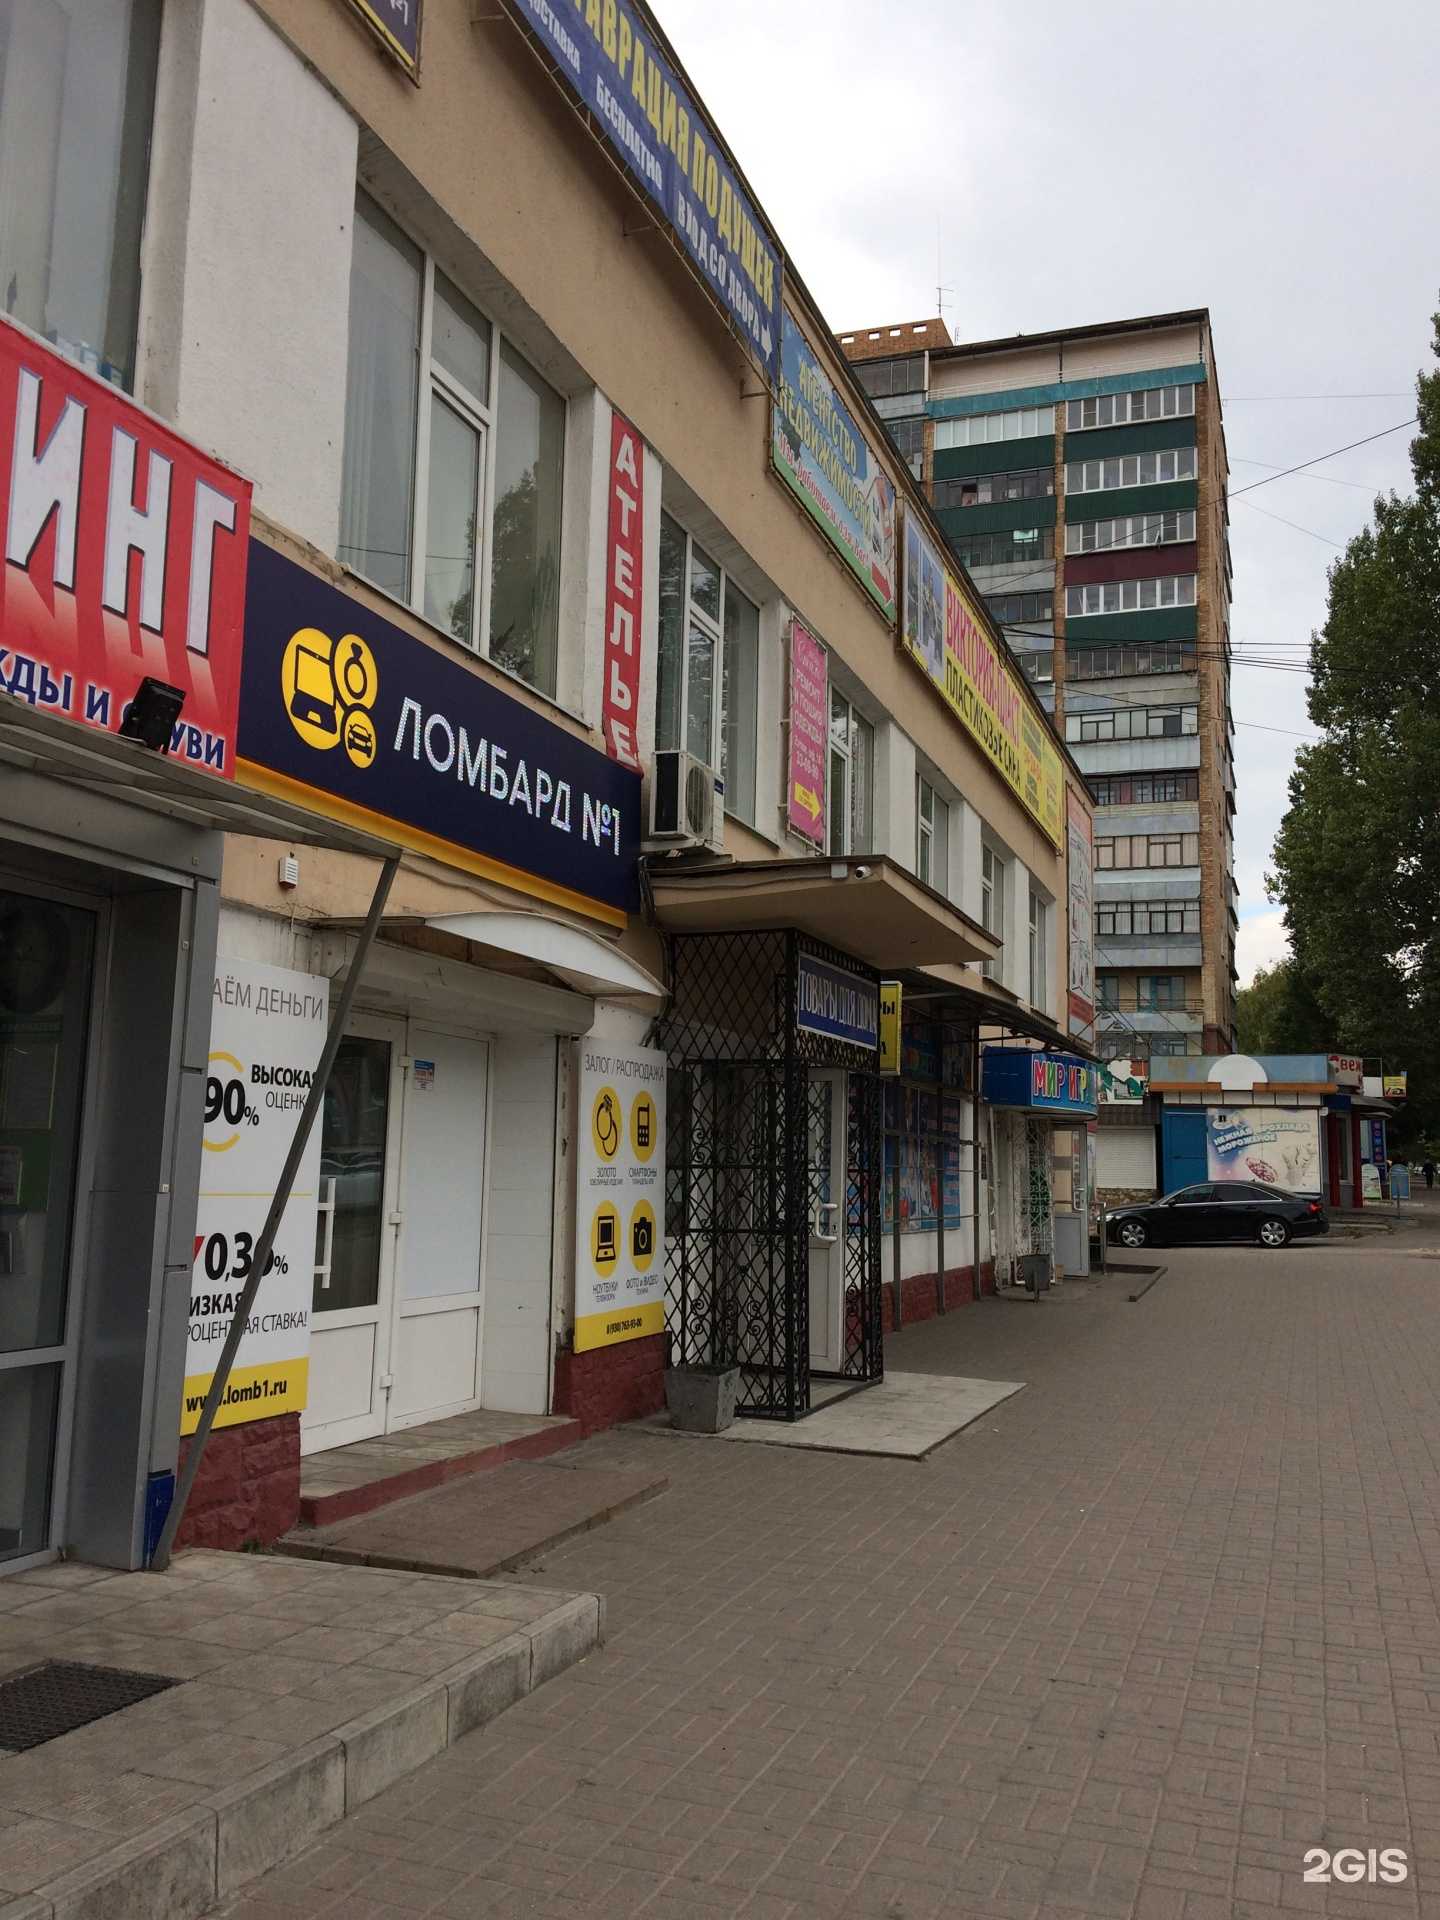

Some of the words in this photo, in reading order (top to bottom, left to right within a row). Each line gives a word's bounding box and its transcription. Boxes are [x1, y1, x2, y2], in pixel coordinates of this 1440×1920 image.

[574, 0, 689, 176] АВРАЦИЯ
[692, 129, 775, 313] ПОДУШЕК
[596, 74, 663, 191] БЕСПЛАТНО
[677, 190, 708, 271] ВХОД
[709, 243, 727, 288] СО
[728, 268, 760, 342] ДВОРА
[6, 366, 239, 658] ИНГ
[610, 433, 640, 768] АТЕЛЬЕ
[122, 701, 225, 770] УВИ
[393, 696, 573, 833] ЛОМБАРД
[582, 792, 621, 856] №1
[255, 986, 323, 1021] ДЕНЬГИ
[800, 969, 838, 1022] ТОВАРЫ
[251, 1064, 316, 1089] ВЫСОКА
[585, 1054, 611, 1074] ЗАЛОГ
[616, 1059, 664, 1081] РАСПРОДАЖА
[1033, 1059, 1065, 1099] МИР
[262, 1310, 308, 1333] СТАВКА!
[185, 1380, 288, 1413] ww.lomb1.ru
